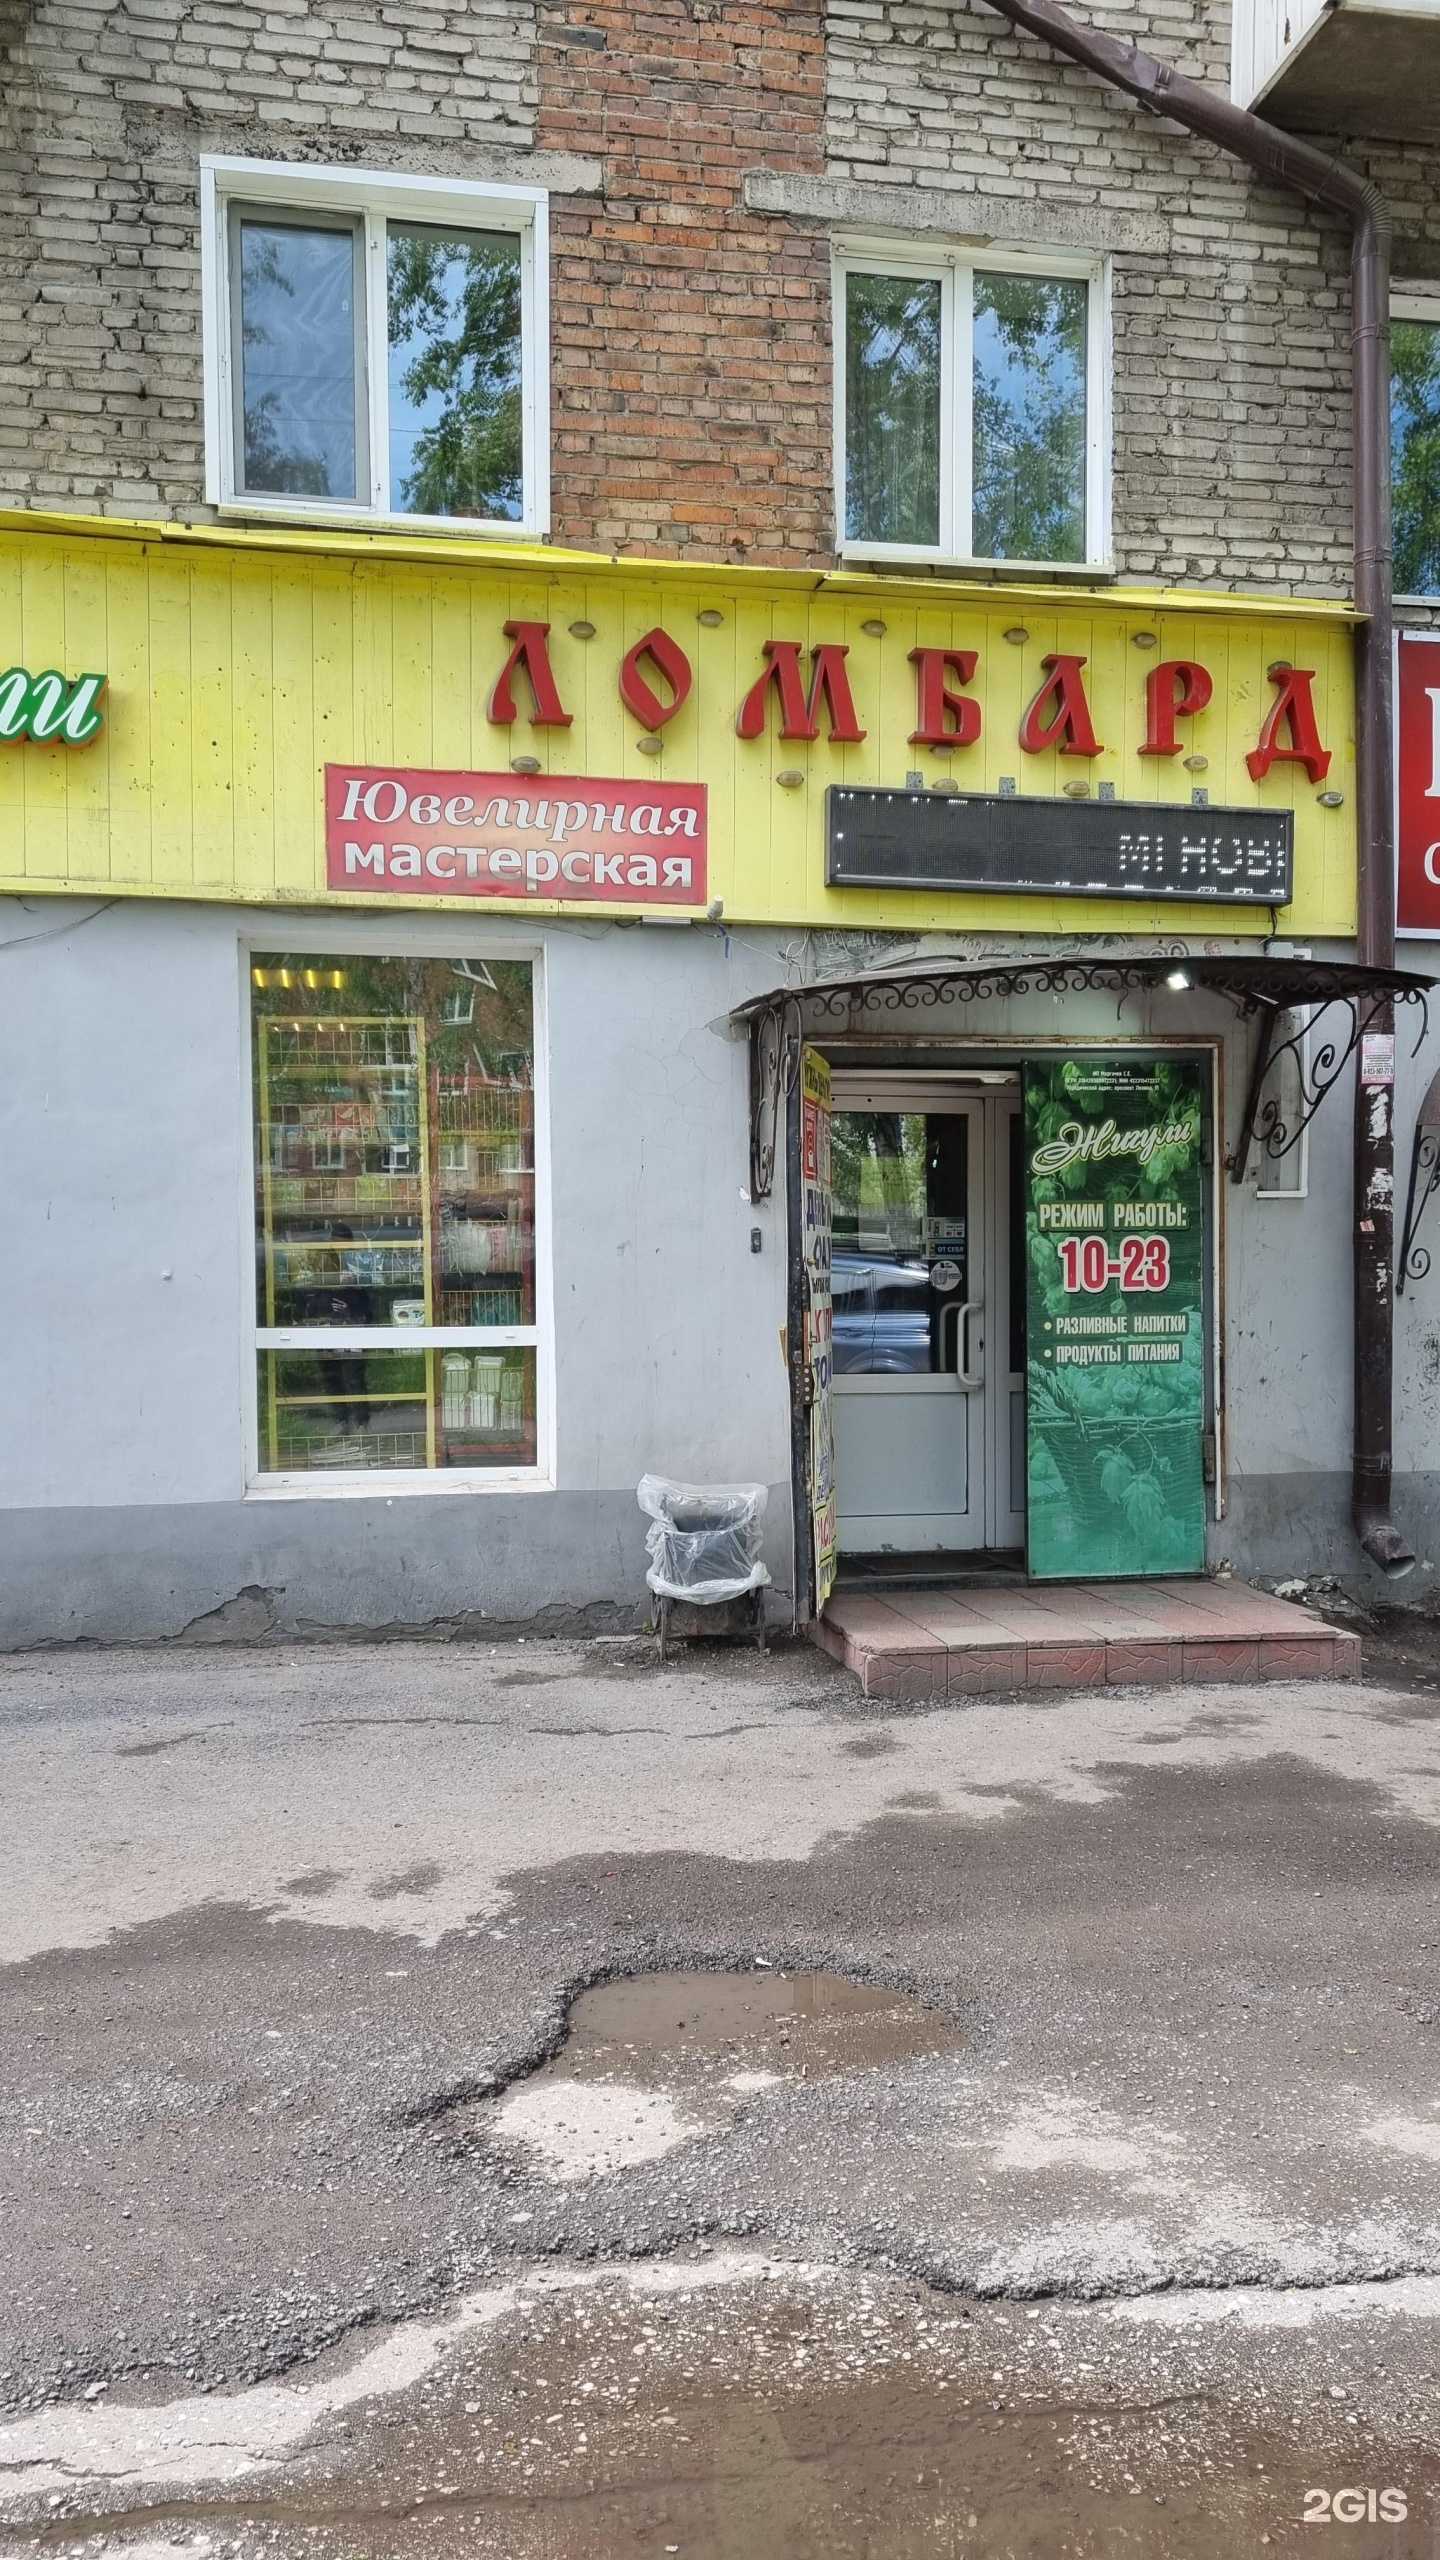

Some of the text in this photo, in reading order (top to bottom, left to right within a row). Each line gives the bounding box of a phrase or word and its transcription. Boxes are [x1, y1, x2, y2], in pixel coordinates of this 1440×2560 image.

[486, 619, 1333, 784] ЛОМБАРД
[336, 779, 700, 843] Ювелирная
[343, 840, 694, 892] мастерская
[1031, 1119, 1193, 1176] Жигули
[1039, 1202, 1188, 1229] РЕЖИМ РАБОТЫ:
[1058, 1235, 1170, 1293] 10-23
[1056, 1314, 1187, 1335] РАЗЛИВНЫЕ НАПИТКИ
[1056, 1343, 1180, 1366] ПРОДУКТЫ ПИТАНИЯ
